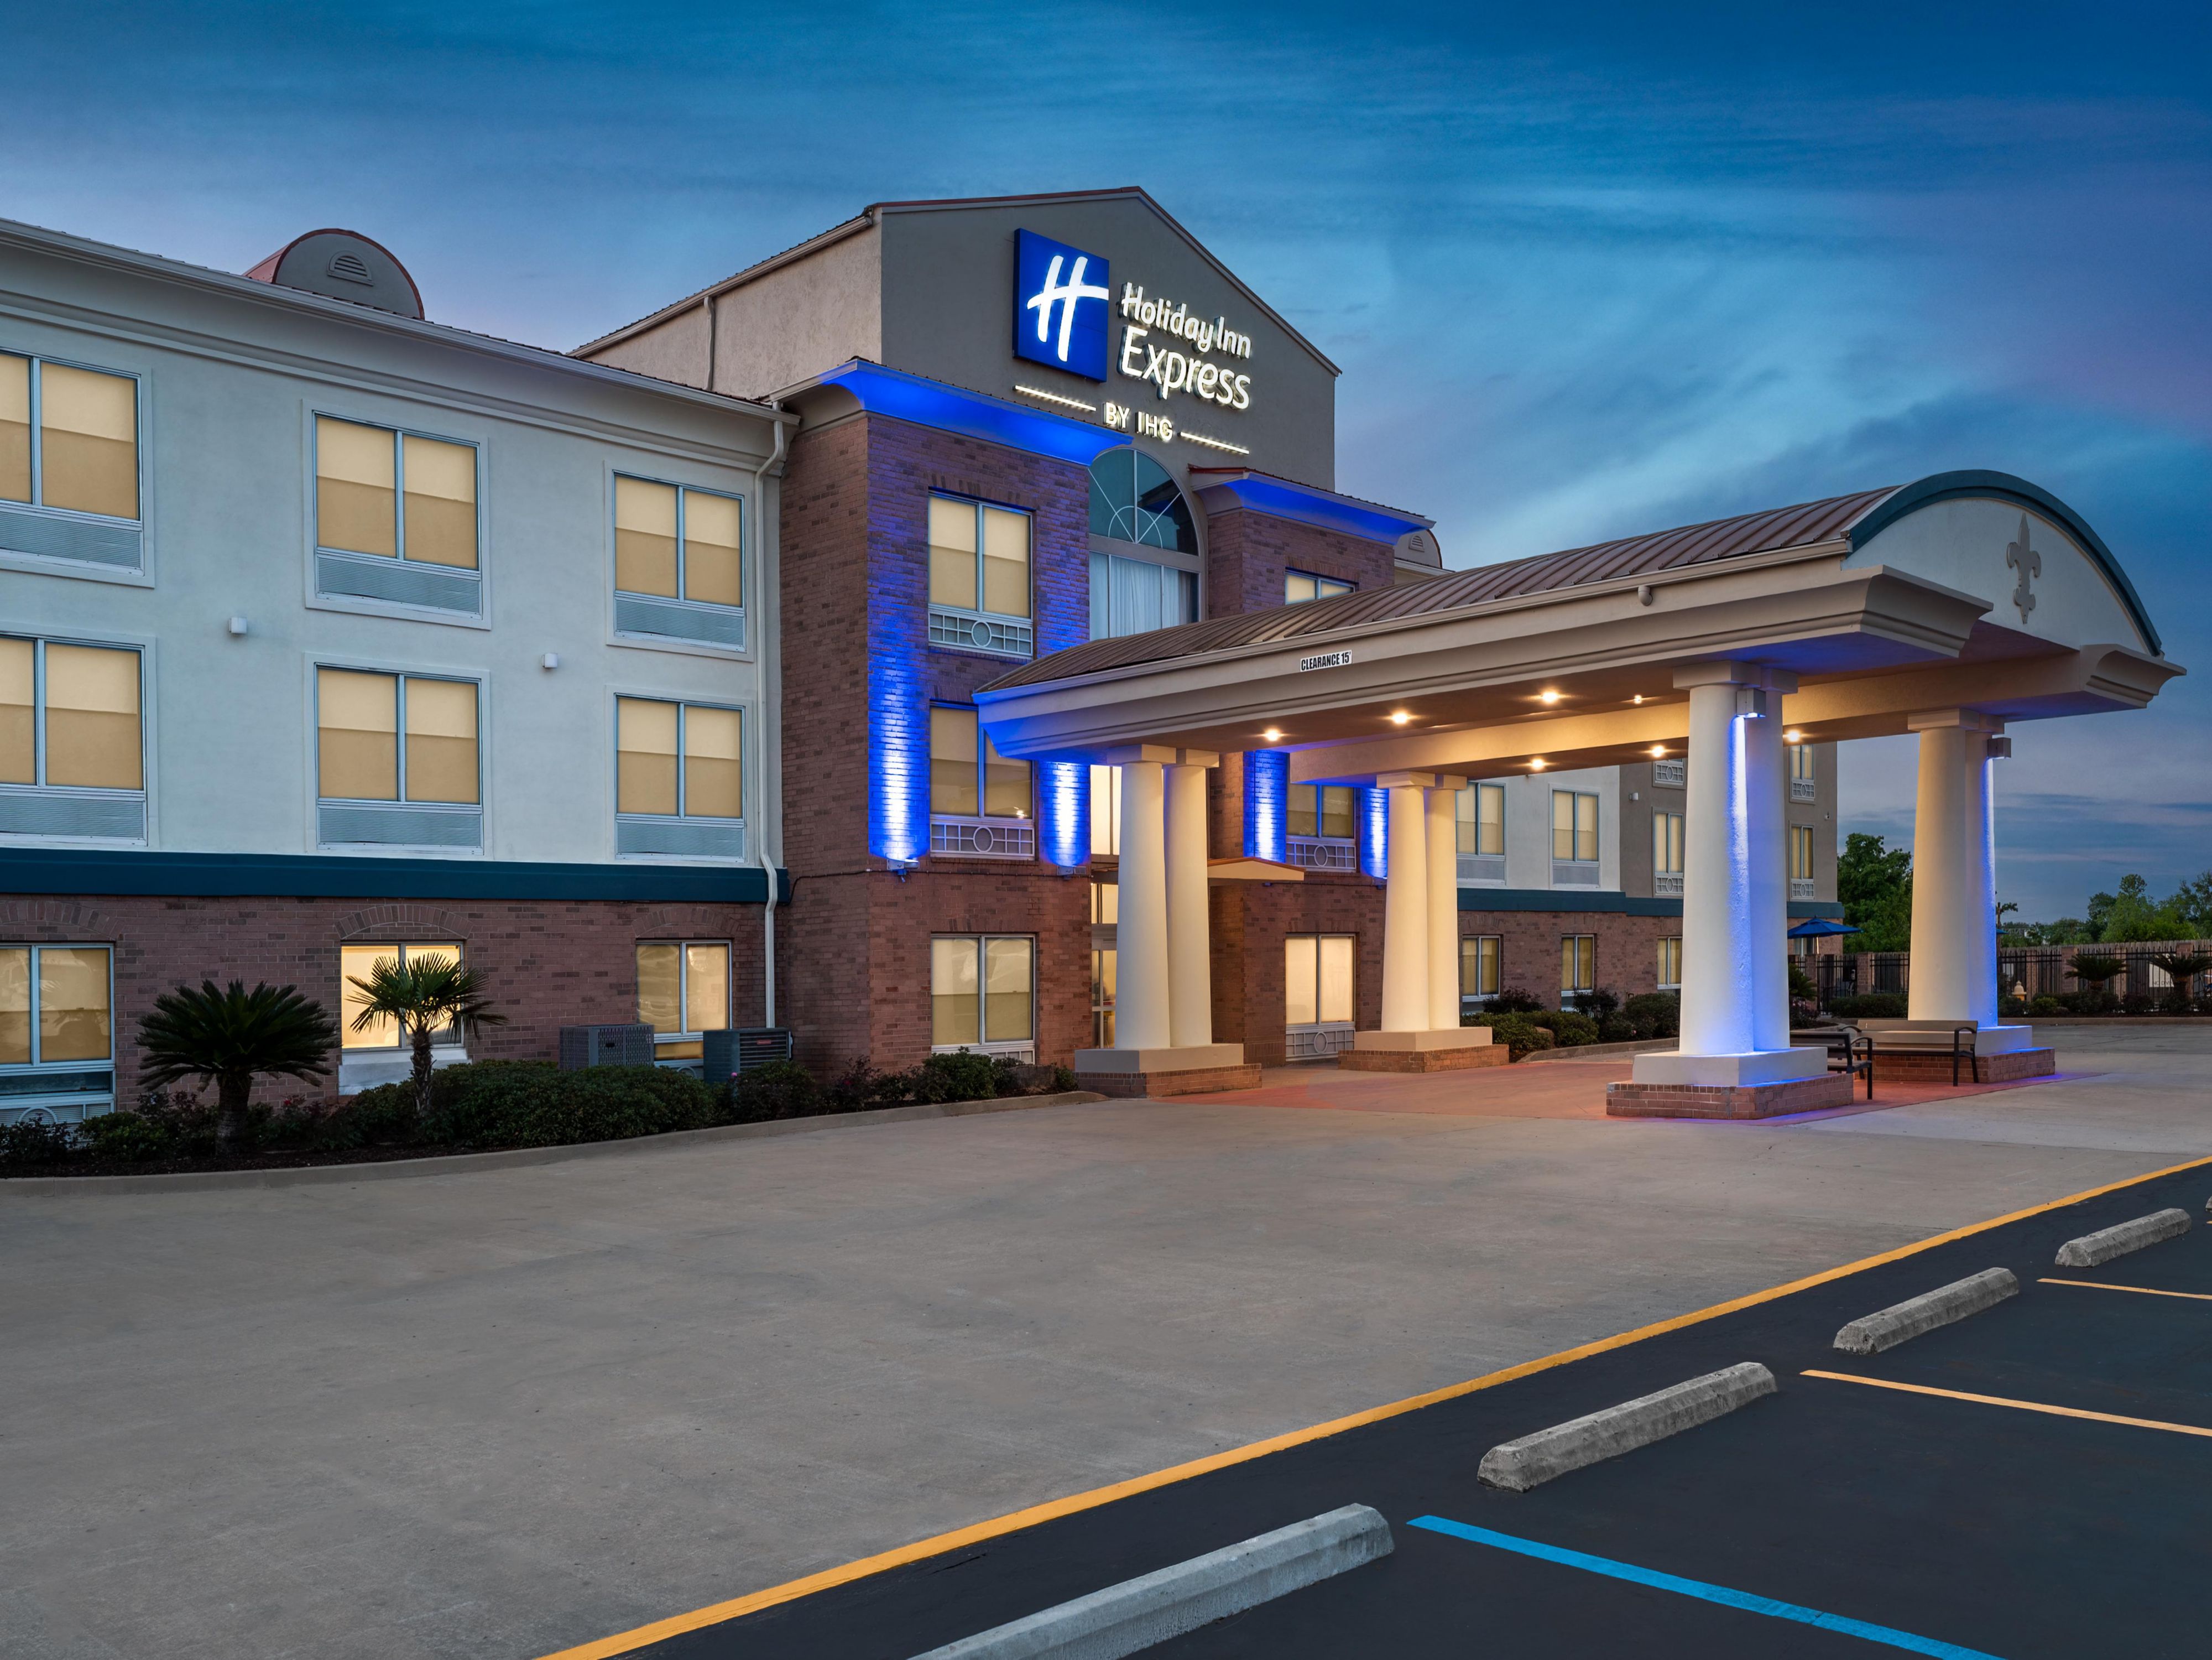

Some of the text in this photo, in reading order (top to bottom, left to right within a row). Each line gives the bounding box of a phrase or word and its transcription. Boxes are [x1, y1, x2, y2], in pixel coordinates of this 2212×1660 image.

[1027, 255, 1109, 362] H
[1120, 282, 1252, 360] Holiday Inn
[1120, 325, 1252, 410] Express
[1104, 402, 1174, 441] BY IHG
[1301, 653, 1340, 671] CLEARANCE
